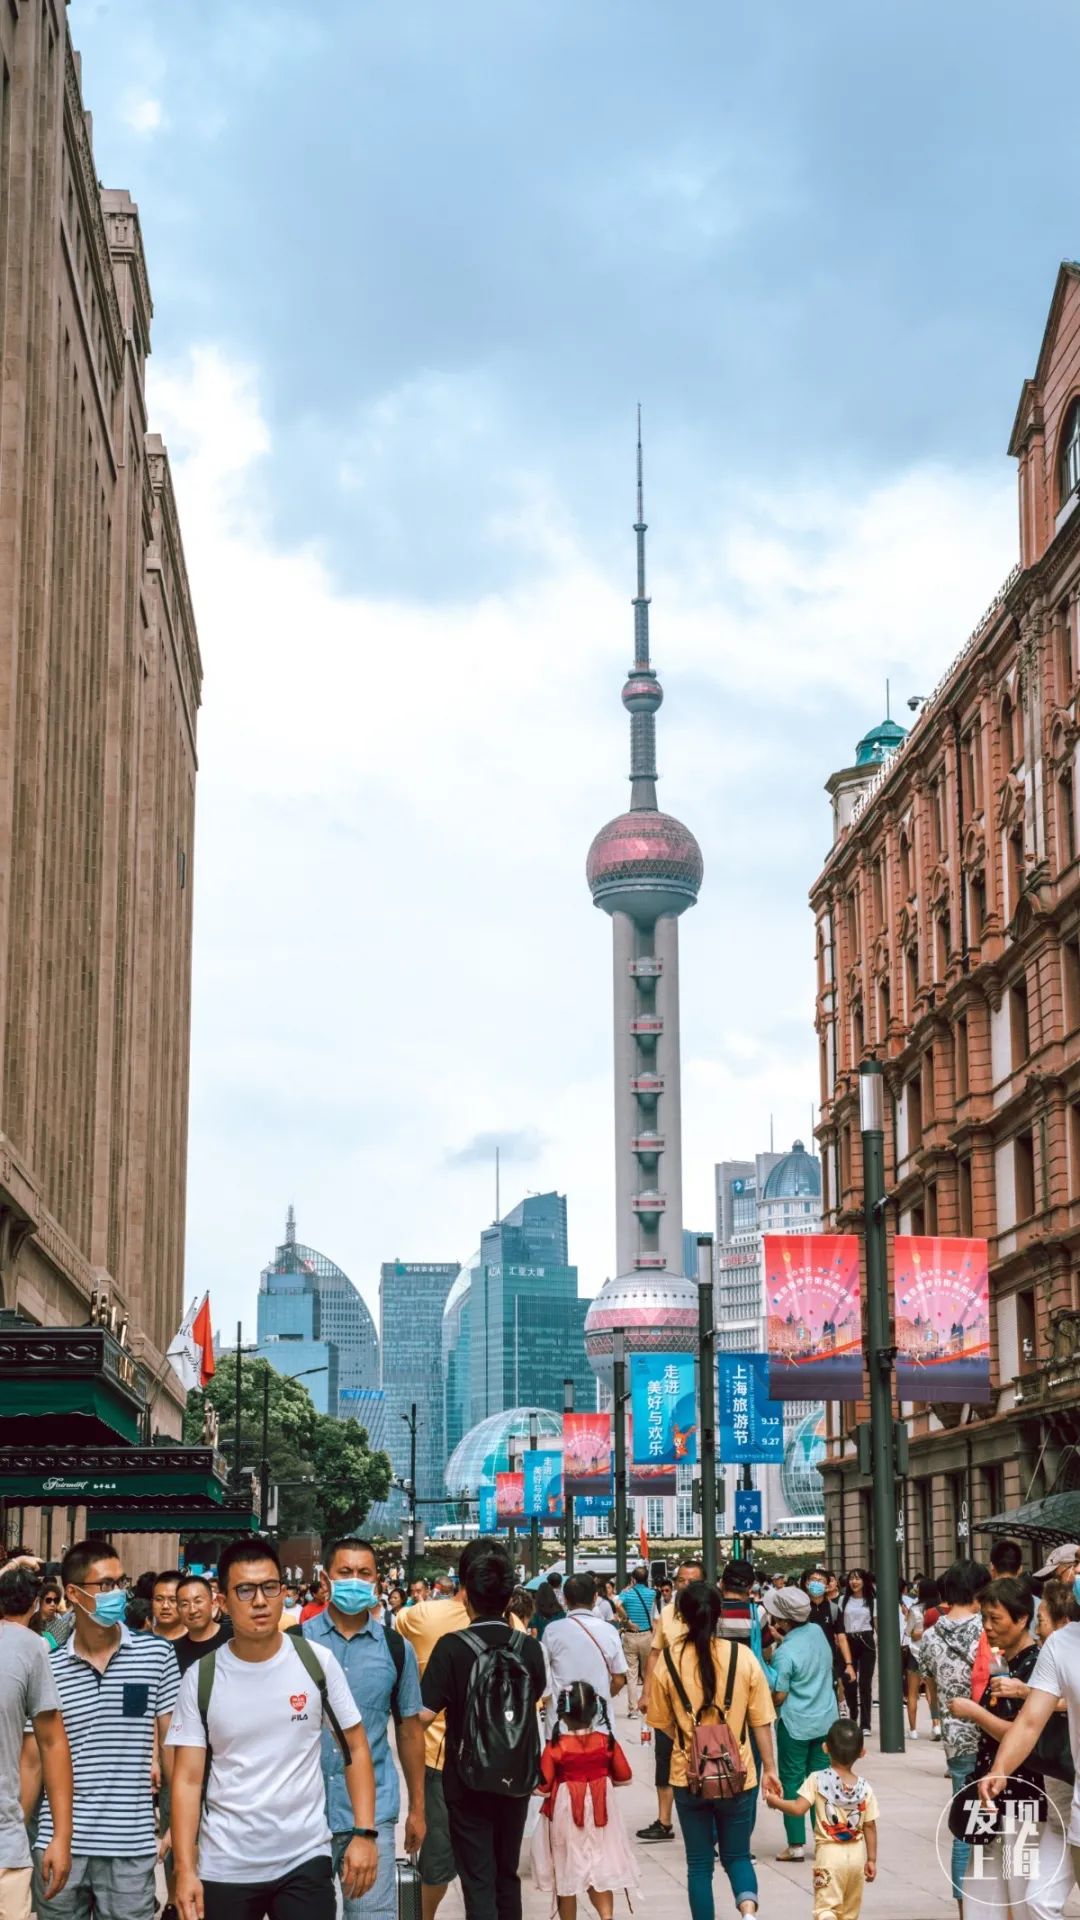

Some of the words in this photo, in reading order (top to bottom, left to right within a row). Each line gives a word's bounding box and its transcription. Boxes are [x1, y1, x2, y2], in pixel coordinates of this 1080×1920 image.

[663, 1364, 680, 1394] 走进
[732, 1364, 749, 1446] 上海旅游节
[647, 1380, 664, 1456] 美好与欢乐
[761, 1417, 780, 1425] 9.12
[761, 1437, 780, 1445] 9.27
[291, 1713, 308, 1722] FILA
